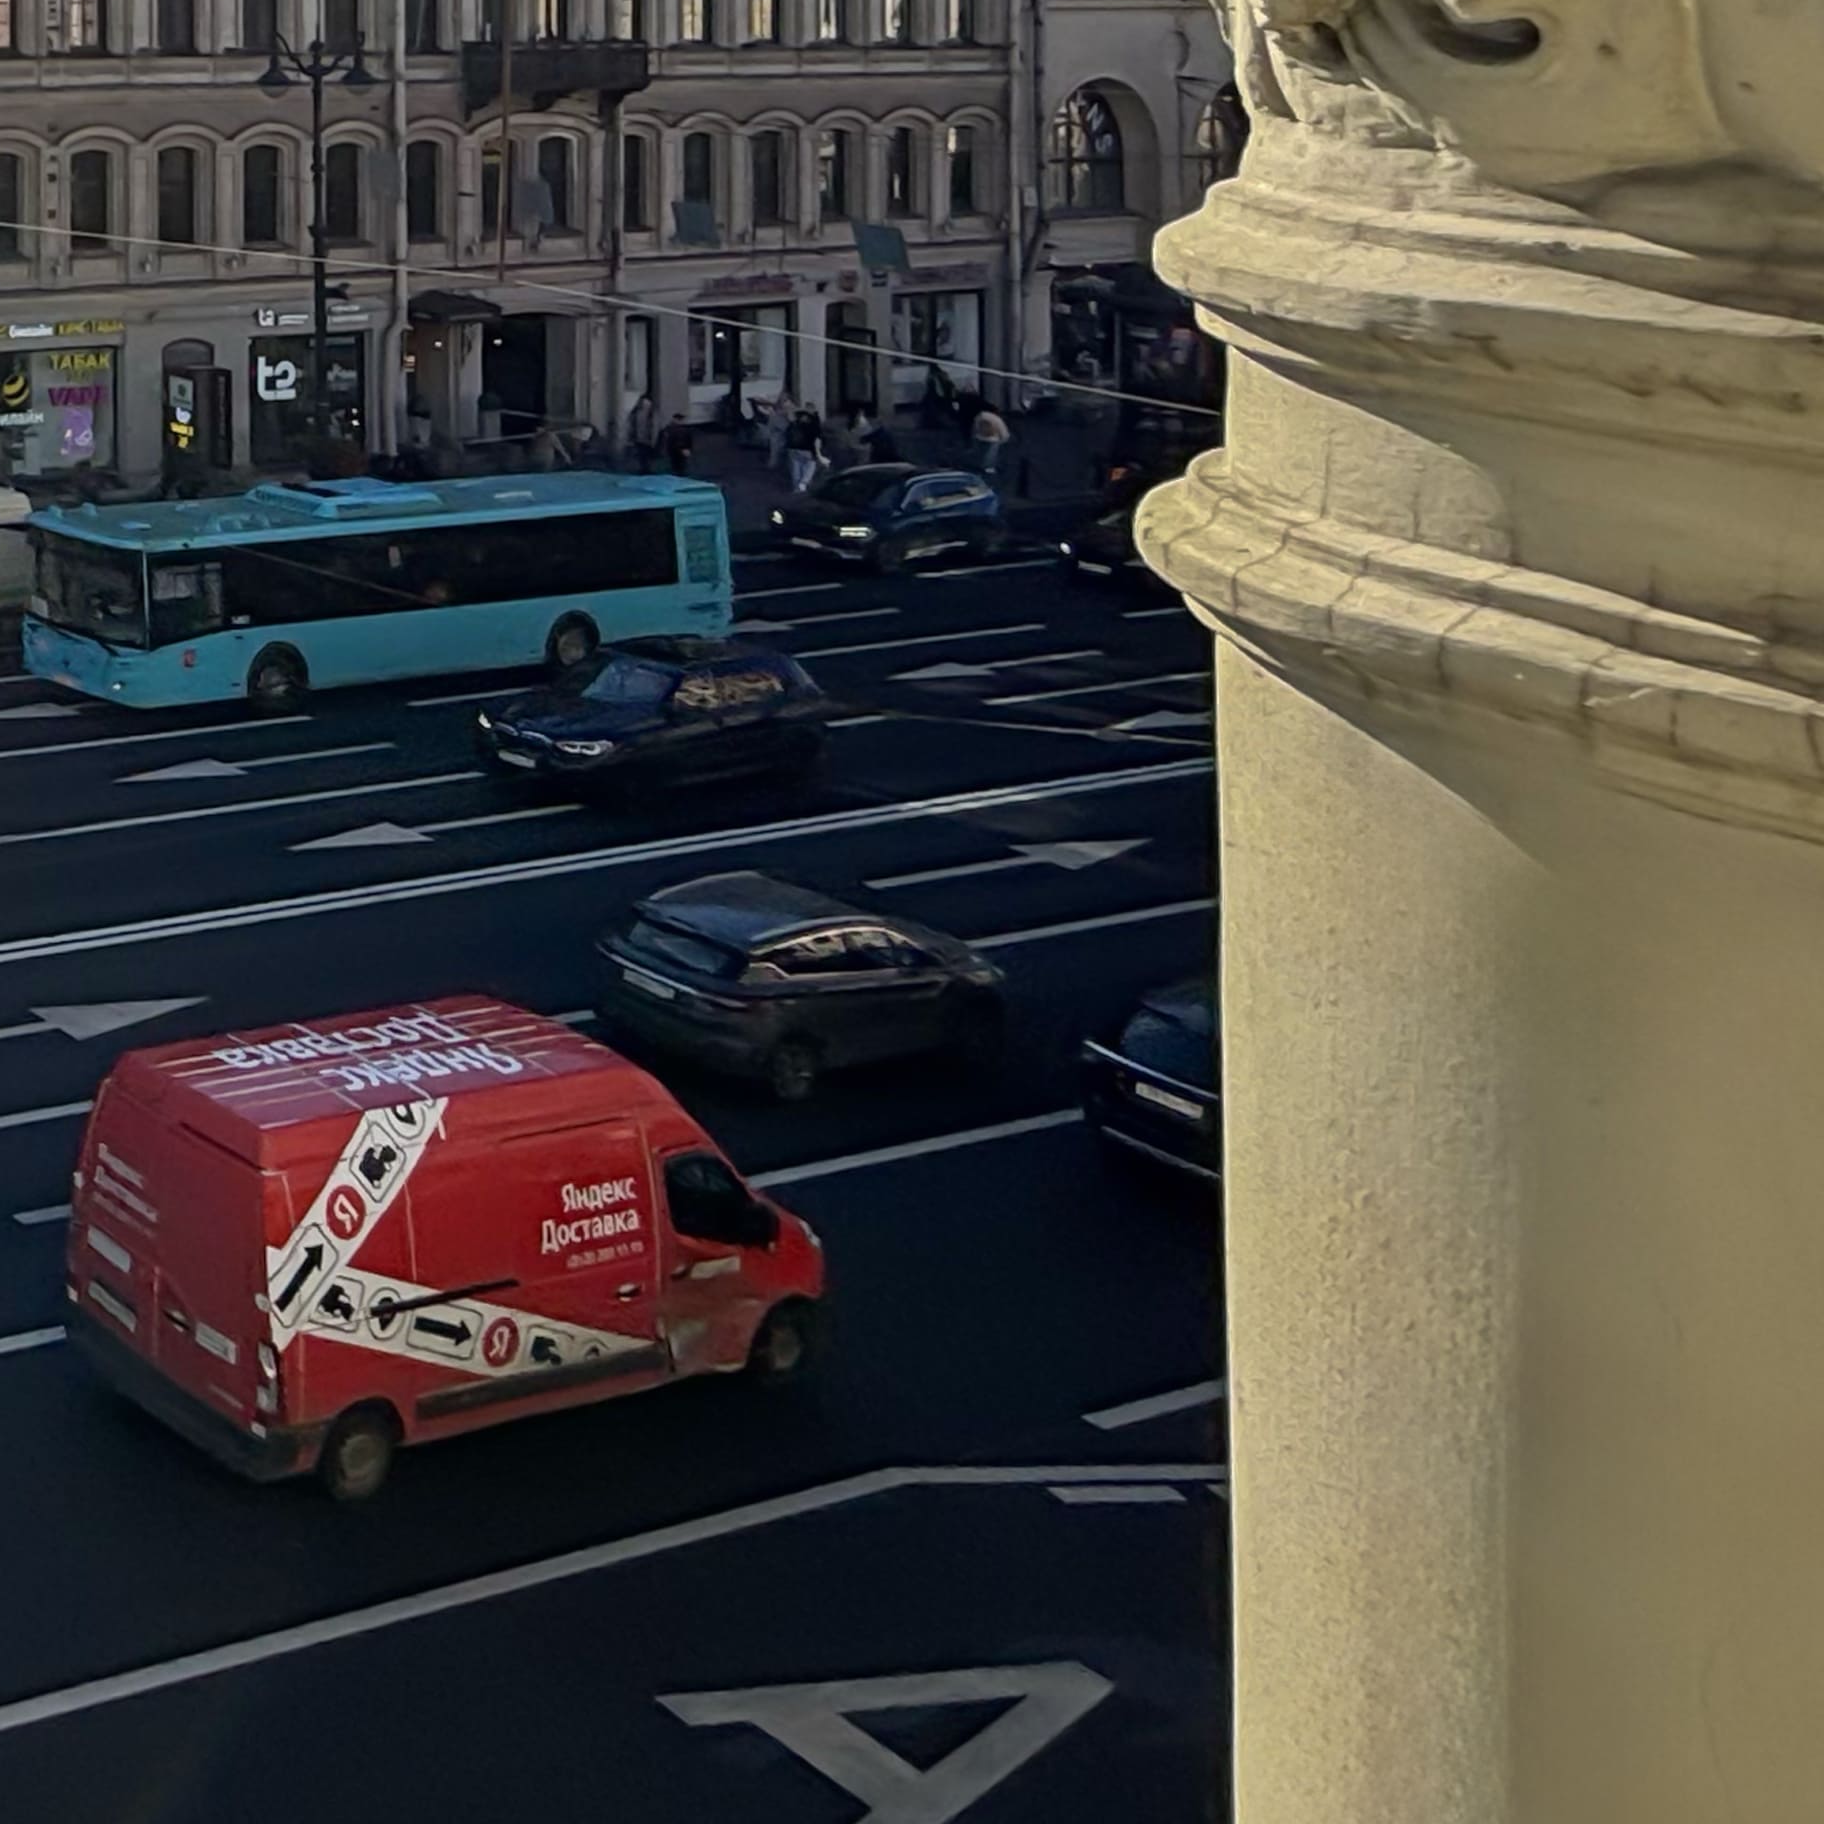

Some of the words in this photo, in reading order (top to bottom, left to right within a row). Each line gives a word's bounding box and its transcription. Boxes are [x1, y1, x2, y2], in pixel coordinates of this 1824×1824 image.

[50, 353, 111, 371] ТАБАК
[560, 1176, 638, 1214] Яндекс
[540, 1208, 641, 1255] Доставка
